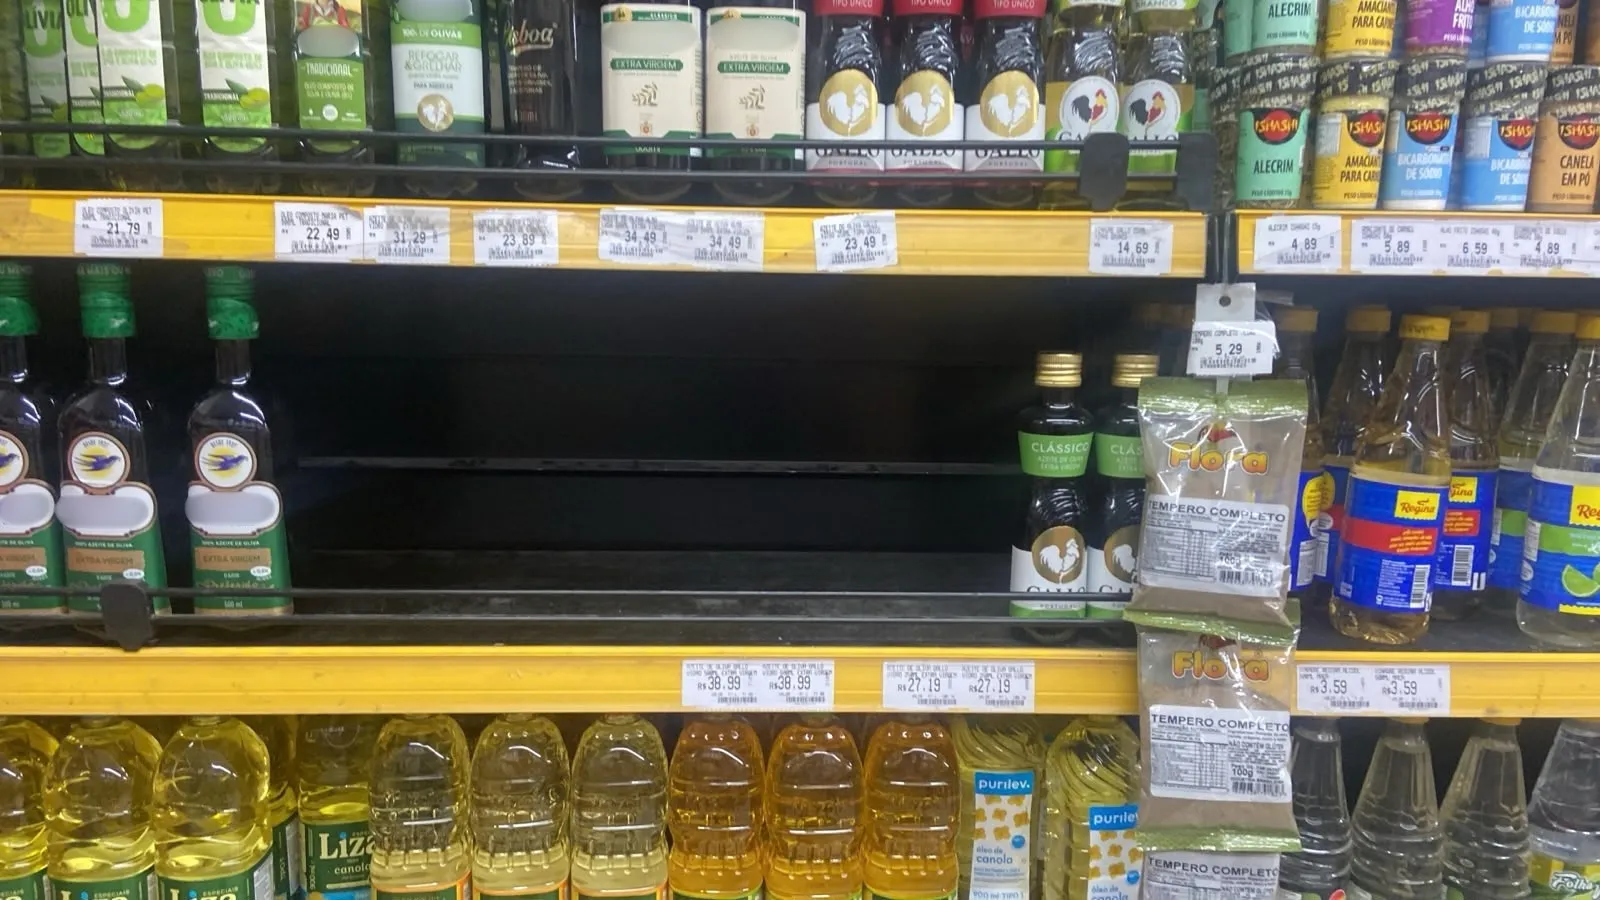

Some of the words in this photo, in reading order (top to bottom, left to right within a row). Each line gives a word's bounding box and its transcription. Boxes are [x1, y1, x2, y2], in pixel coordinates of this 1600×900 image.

[1268, 2, 1311, 19] ALECRIM
[1352, 15, 1374, 29] PARA
[1524, 20, 1536, 33] DE
[431, 28, 462, 40] OLIVAS
[408, 50, 459, 63] REFOGAR
[306, 62, 353, 77] TRADICIONAL
[616, 59, 642, 70] EXTRA
[644, 59, 677, 70] VIRGEM
[724, 62, 750, 73] EXTRA
[752, 62, 784, 73] VIRGEM
[1253, 159, 1294, 174] ALECRIM
[1560, 155, 1594, 169] CANELA
[1340, 169, 1361, 183] PARA
[1405, 167, 1417, 180] DE
[1500, 172, 1512, 185] DE
[1561, 172, 1576, 187] EM
[1578, 170, 1590, 187] PÓ
[1031, 441, 1090, 454] CLÁSSICO
[1168, 441, 1270, 476] Flora
[1209, 506, 1286, 522] COMPLETO
[1400, 500, 1435, 515] Regina
[203, 555, 228, 563] EXTRA
[230, 555, 261, 563] VIRGEM
[1172, 650, 1270, 682] Flora
[697, 682, 706, 690] R$
[769, 682, 777, 690] R$
[897, 684, 906, 692] R$
[969, 685, 977, 693] R$
[1382, 687, 1390, 695] R$
[1151, 713, 1214, 728] TEMPERO
[1218, 719, 1289, 732] COMPLETO
[1232, 768, 1254, 778] 100g
[976, 852, 1013, 864] canola
[1148, 856, 1208, 873] TEMPERO
[1212, 865, 1279, 877] COMPLETO
[974, 891, 989, 899] 900
[1091, 884, 1108, 893] óleo
[1109, 885, 1119, 893] de
